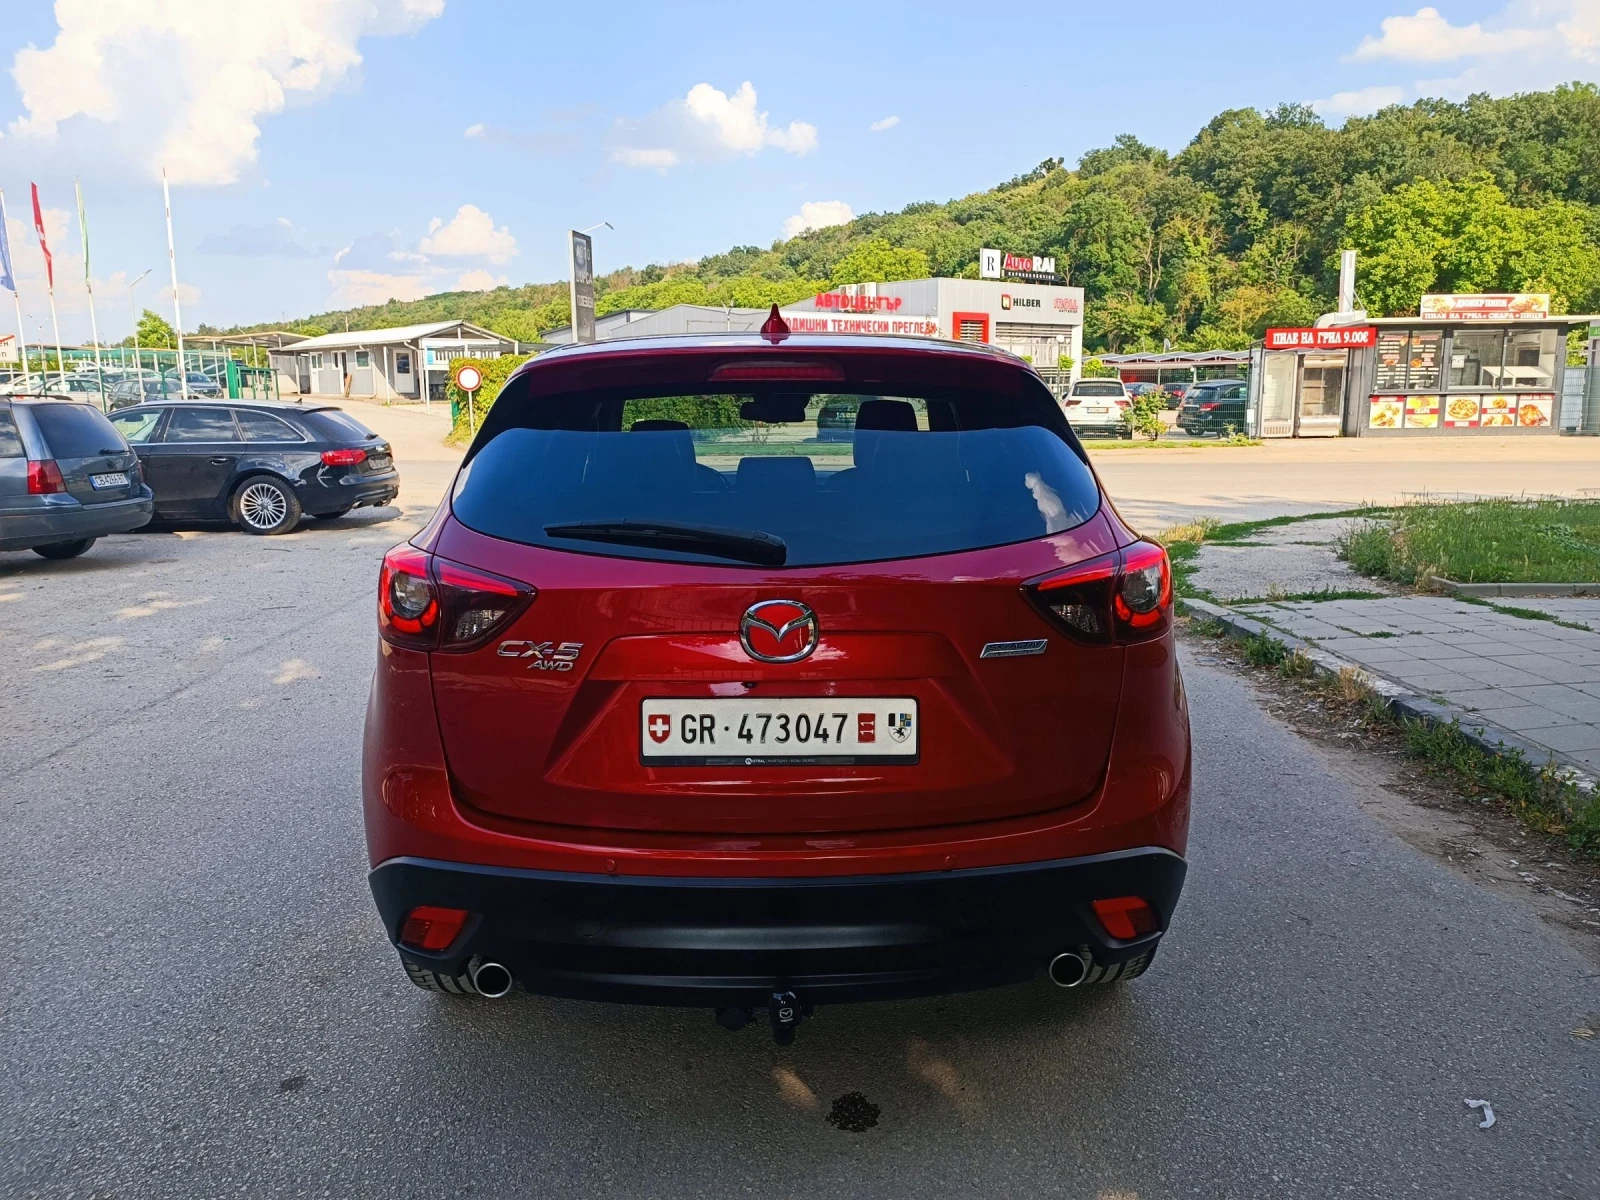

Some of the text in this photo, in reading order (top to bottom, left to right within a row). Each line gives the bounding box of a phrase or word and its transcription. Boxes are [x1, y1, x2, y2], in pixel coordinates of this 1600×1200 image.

[986, 255, 995, 272] R
[814, 292, 902, 312] АВТОЦЕНТЪР
[1013, 297, 1041, 308] HILBER
[831, 318, 890, 333] ТЕХНИЧЕСКИ
[1272, 332, 1299, 345] ПИЛЕ
[1300, 332, 1314, 344] НА
[1317, 331, 1342, 344] ГРИЛ
[1343, 331, 1369, 344] 9.00€
[496, 640, 585, 661] CX-5
[526, 660, 574, 672] AWD
[680, 712, 849, 744] GR 473047
